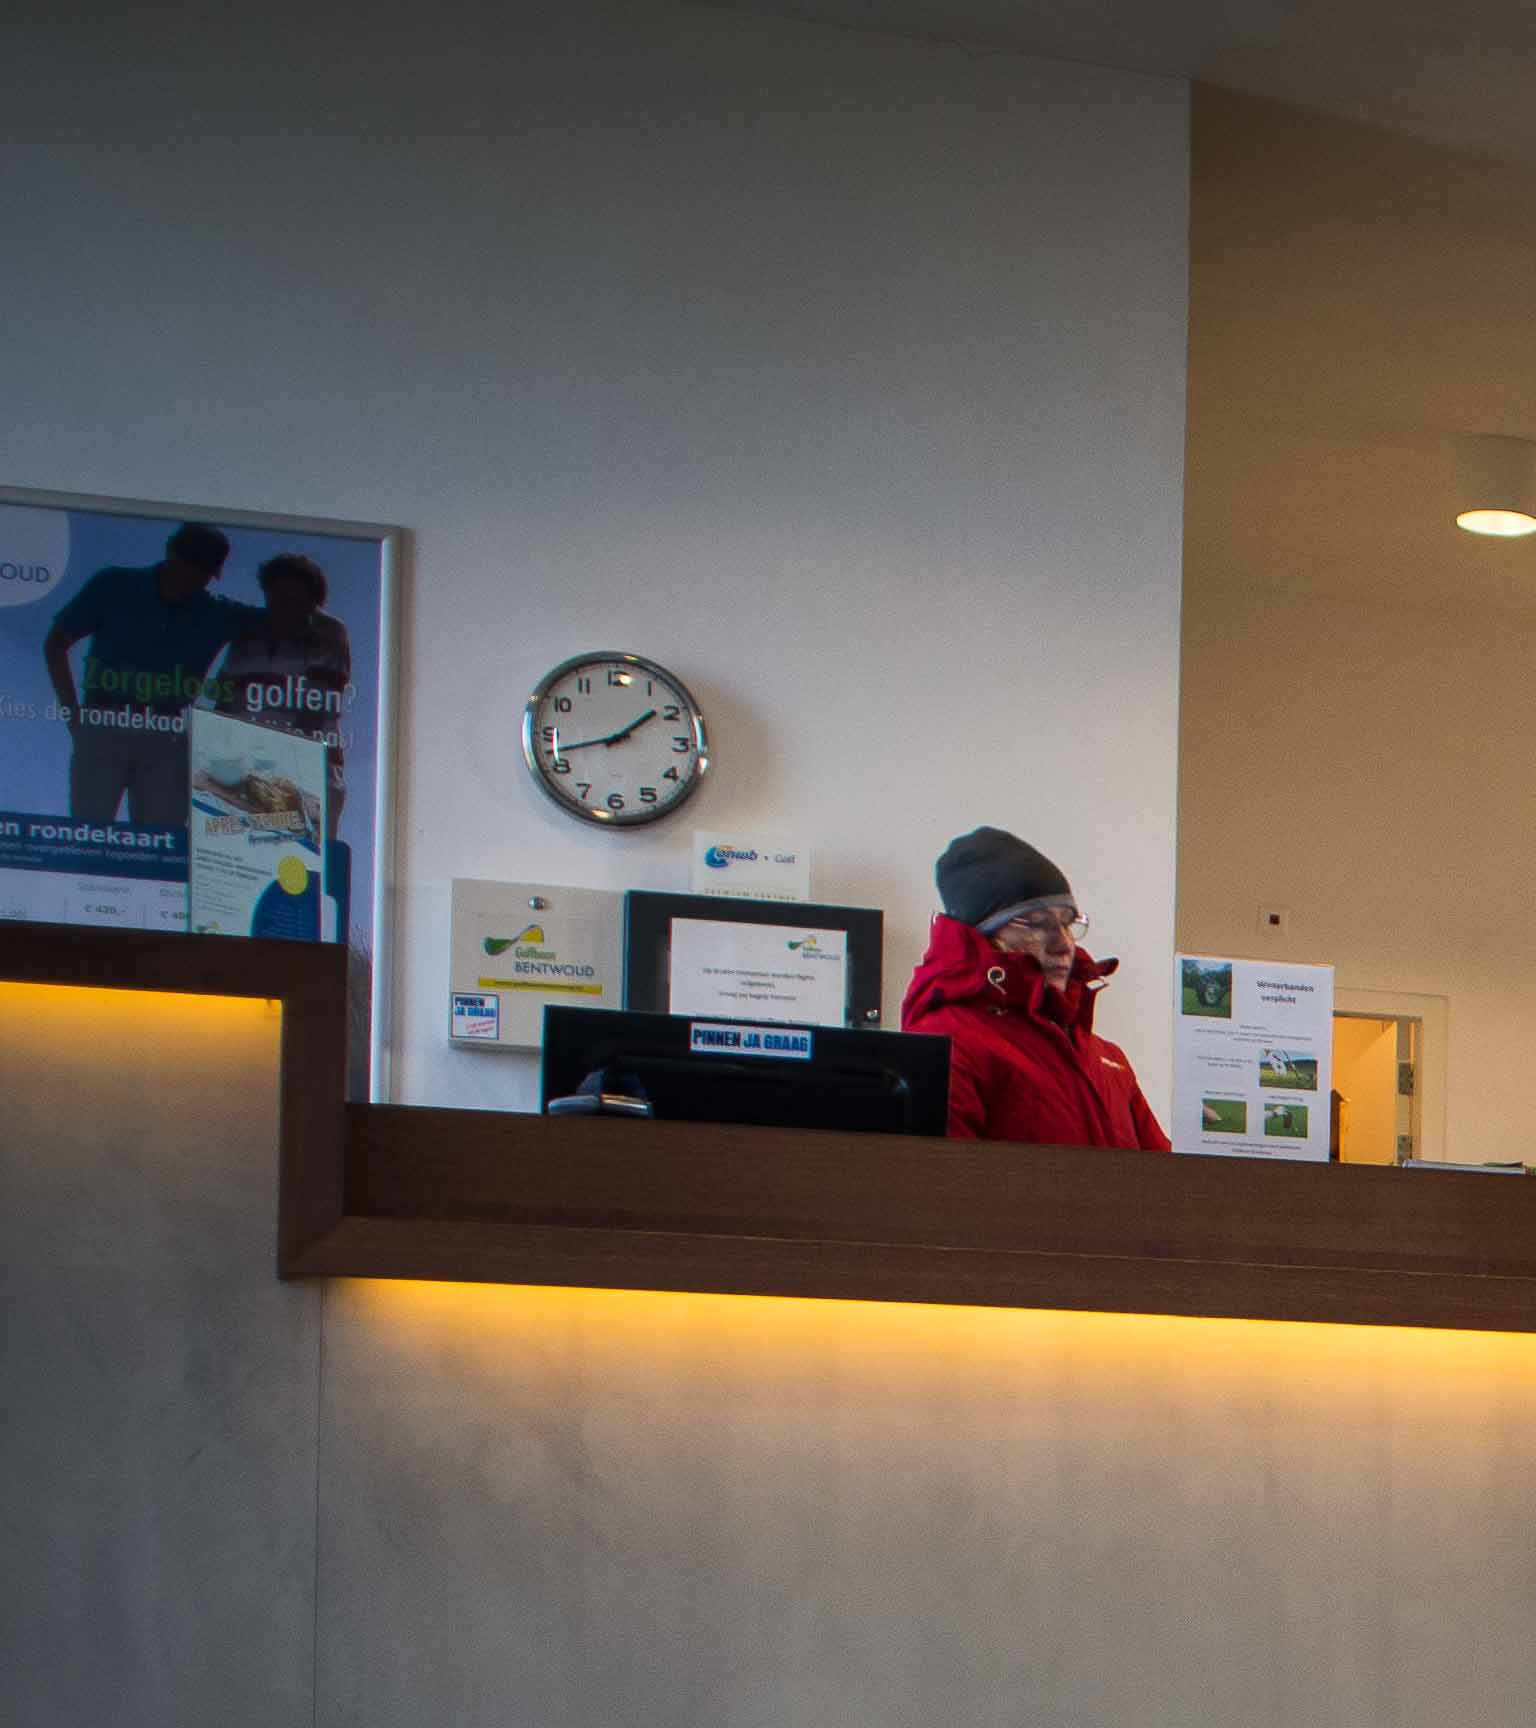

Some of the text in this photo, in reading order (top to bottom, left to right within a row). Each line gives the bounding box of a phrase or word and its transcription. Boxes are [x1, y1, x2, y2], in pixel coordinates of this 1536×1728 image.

[577, 677, 591, 694] 11
[554, 697, 572, 712] 10
[663, 705, 681, 721] 2
[671, 737, 689, 753] 3
[553, 757, 571, 774] 8
[661, 767, 679, 781] 4
[576, 783, 592, 799] 7
[640, 787, 657, 802] 5
[607, 794, 624, 809] 6
[29, 823, 175, 849] rondekaart
[514, 961, 595, 977] BENTWOUD
[692, 1027, 809, 1052] PINNEN JA GRAAG
